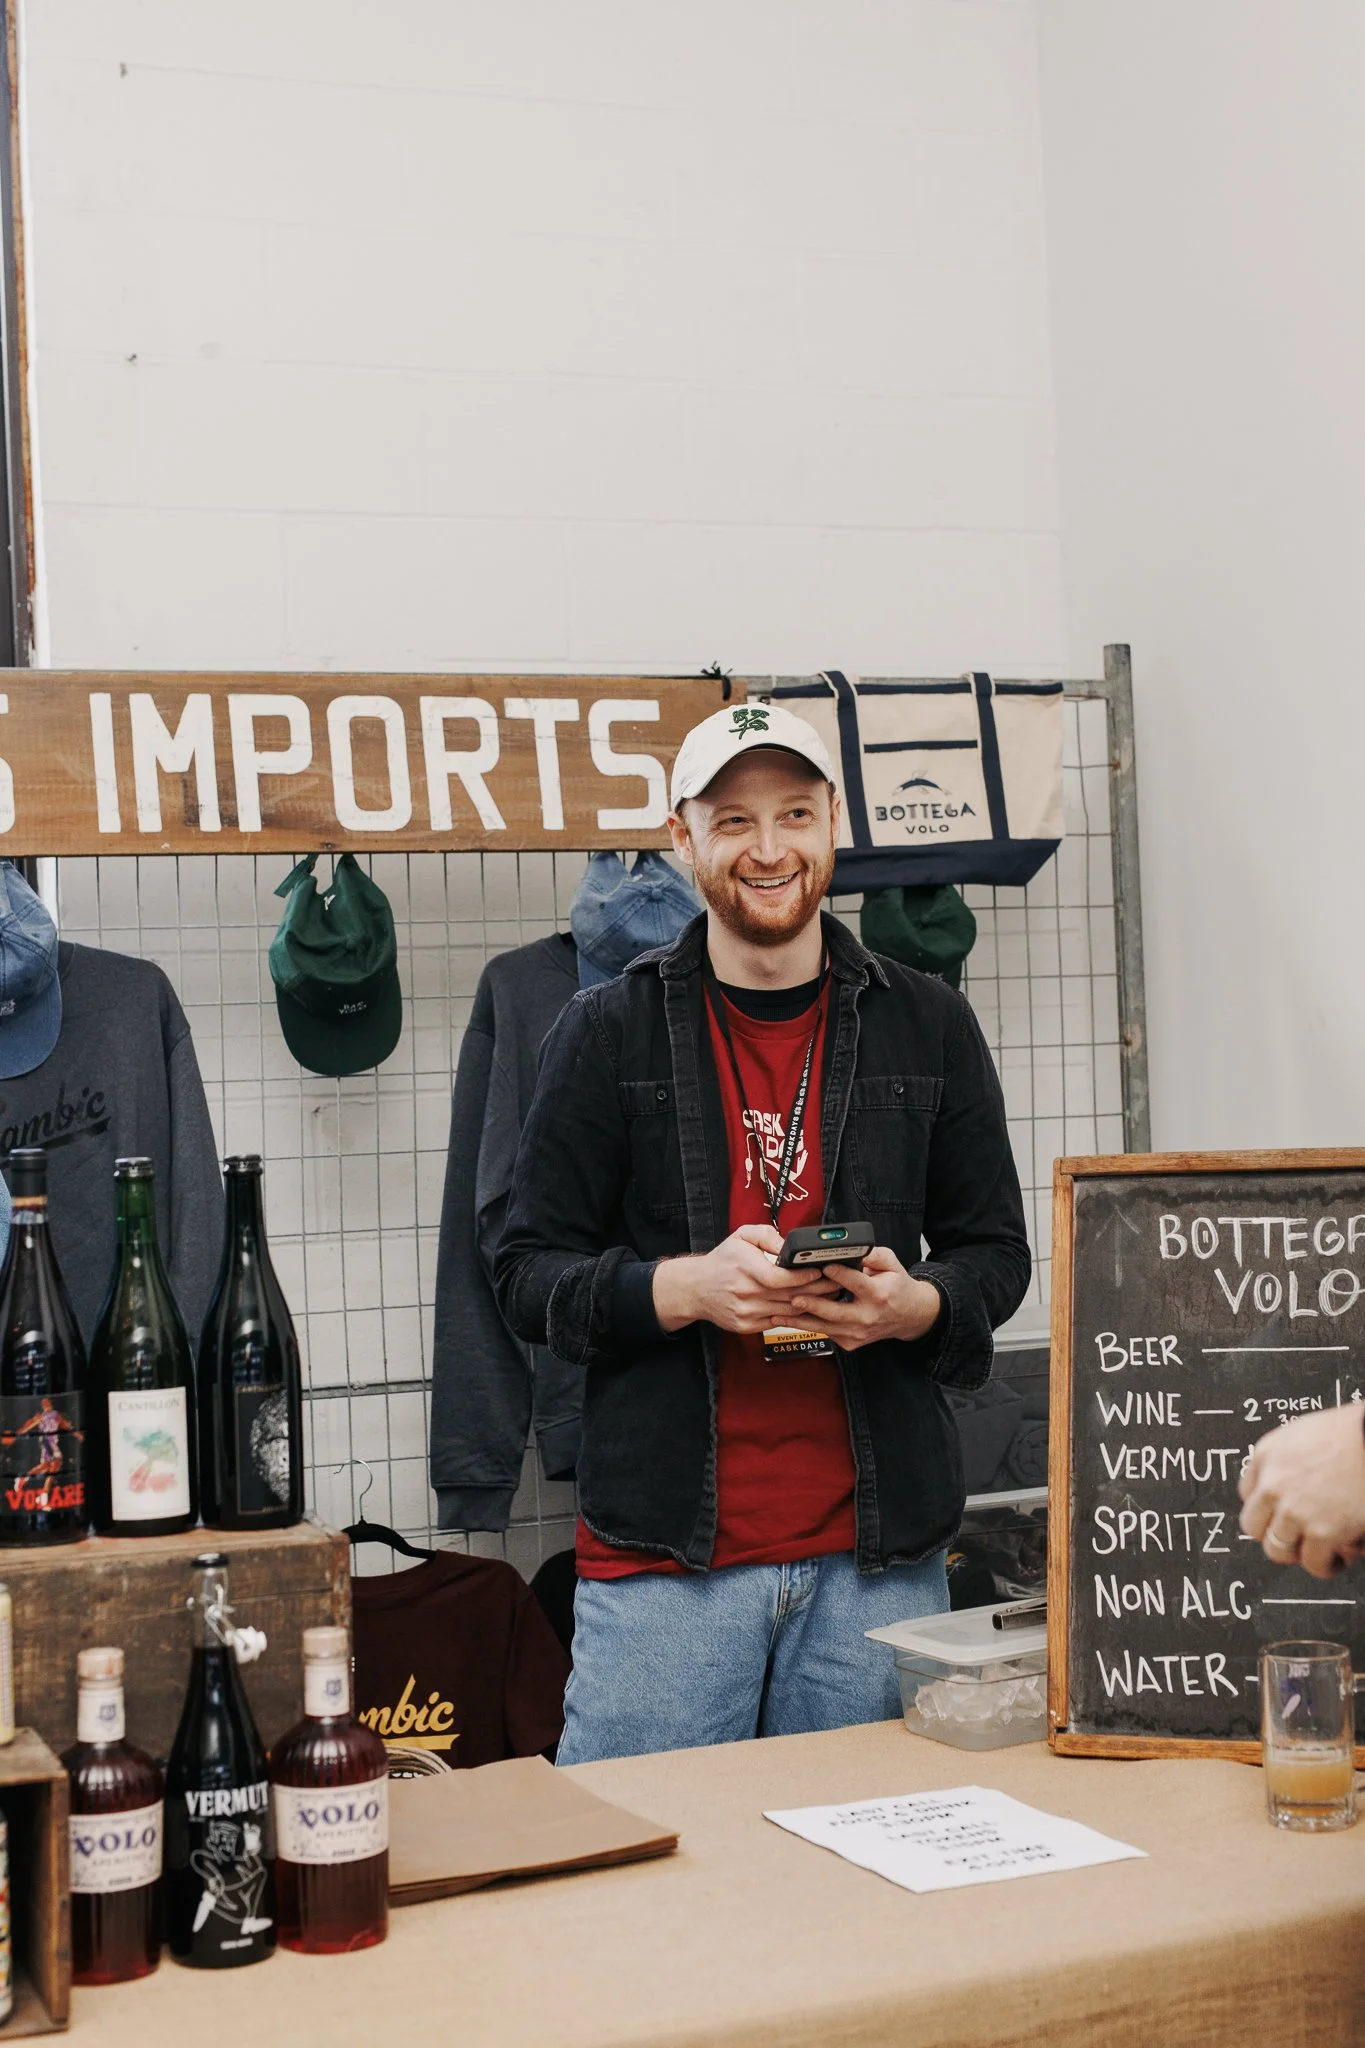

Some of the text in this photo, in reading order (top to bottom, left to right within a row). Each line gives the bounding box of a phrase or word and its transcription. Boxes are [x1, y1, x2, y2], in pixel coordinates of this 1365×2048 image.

[89, 693, 668, 833] IMPORTS
[875, 802, 976, 821] BOTTEGA
[906, 819, 949, 834] VOLO
[743, 1109, 785, 1136] CASK
[1214, 1268, 1365, 1319] VOLO
[773, 1344, 798, 1353] CASK
[800, 1341, 825, 1350] DAYS
[1095, 1332, 1183, 1373] BEER
[1096, 1391, 1182, 1427] WINE
[1243, 1398, 1262, 1422] 2
[1263, 1395, 1323, 1413] TOKEN
[1099, 1443, 1240, 1482] VERMUT
[1092, 1505, 1231, 1555] SPRITZ
[1094, 1574, 1252, 1619] NON ALC
[1096, 1650, 1239, 1697] WATER
[359, 1673, 454, 1735] mbic
[185, 1780, 269, 1817] VERMUT
[300, 1801, 379, 1829] VOLO
[829, 1814, 887, 1827] FOOD
[914, 1800, 975, 1814] DRINK
[836, 1806, 884, 1818] LAST
[74, 1826, 156, 1858] VOLO
